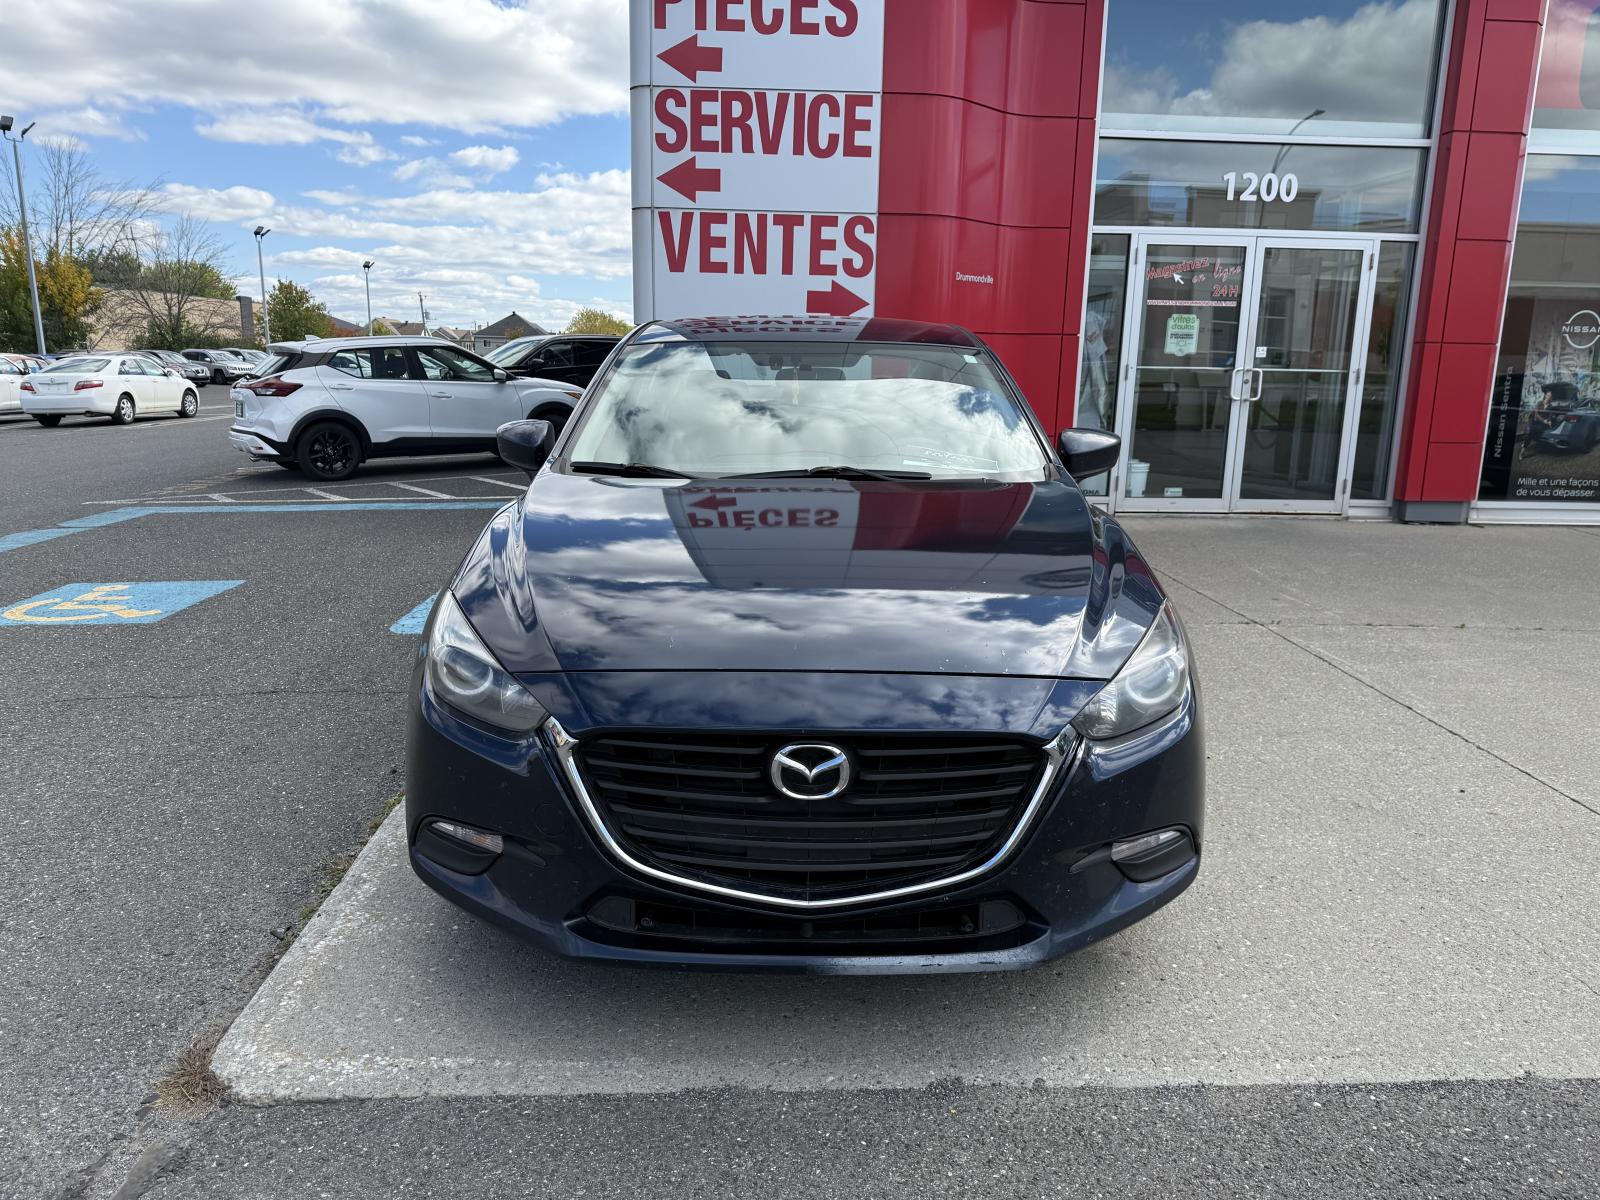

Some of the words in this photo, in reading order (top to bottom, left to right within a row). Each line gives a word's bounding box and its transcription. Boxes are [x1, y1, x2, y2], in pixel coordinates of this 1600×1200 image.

[655, 89, 874, 158] SERVICE
[1223, 172, 1298, 203] 1200
[658, 211, 875, 278] VENTES
[956, 271, 994, 284] Drummondville
[1192, 274, 1206, 284] en
[1213, 258, 1242, 283] ligne
[1172, 316, 1196, 324] vitres
[1494, 413, 1507, 458] Nissan
[1501, 366, 1514, 411] Sentra
[1516, 488, 1528, 496] de
[1529, 488, 1552, 496] vous
[1552, 487, 1595, 498] dépasser.
[1517, 477, 1538, 487] Mille
[1538, 477, 1549, 487] et
[1549, 478, 1568, 487] une
[1568, 476, 1599, 488] façons
